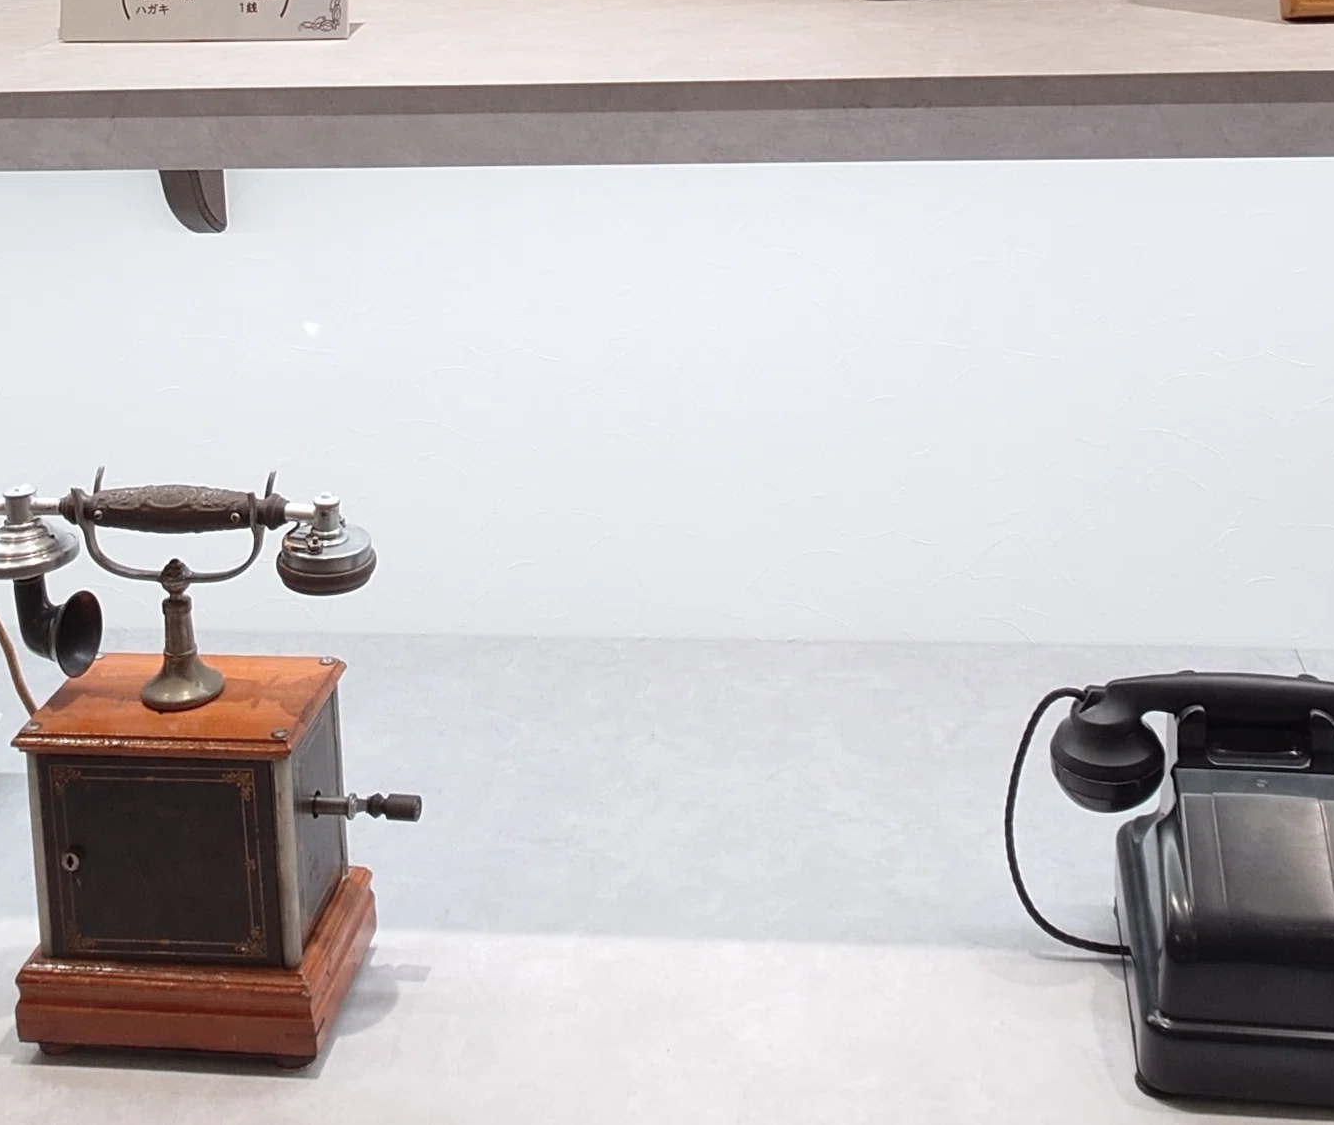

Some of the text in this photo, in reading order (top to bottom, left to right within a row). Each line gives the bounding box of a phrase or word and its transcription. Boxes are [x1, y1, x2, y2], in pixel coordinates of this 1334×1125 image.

[135, 2, 258, 15] ハガキ 1銭
